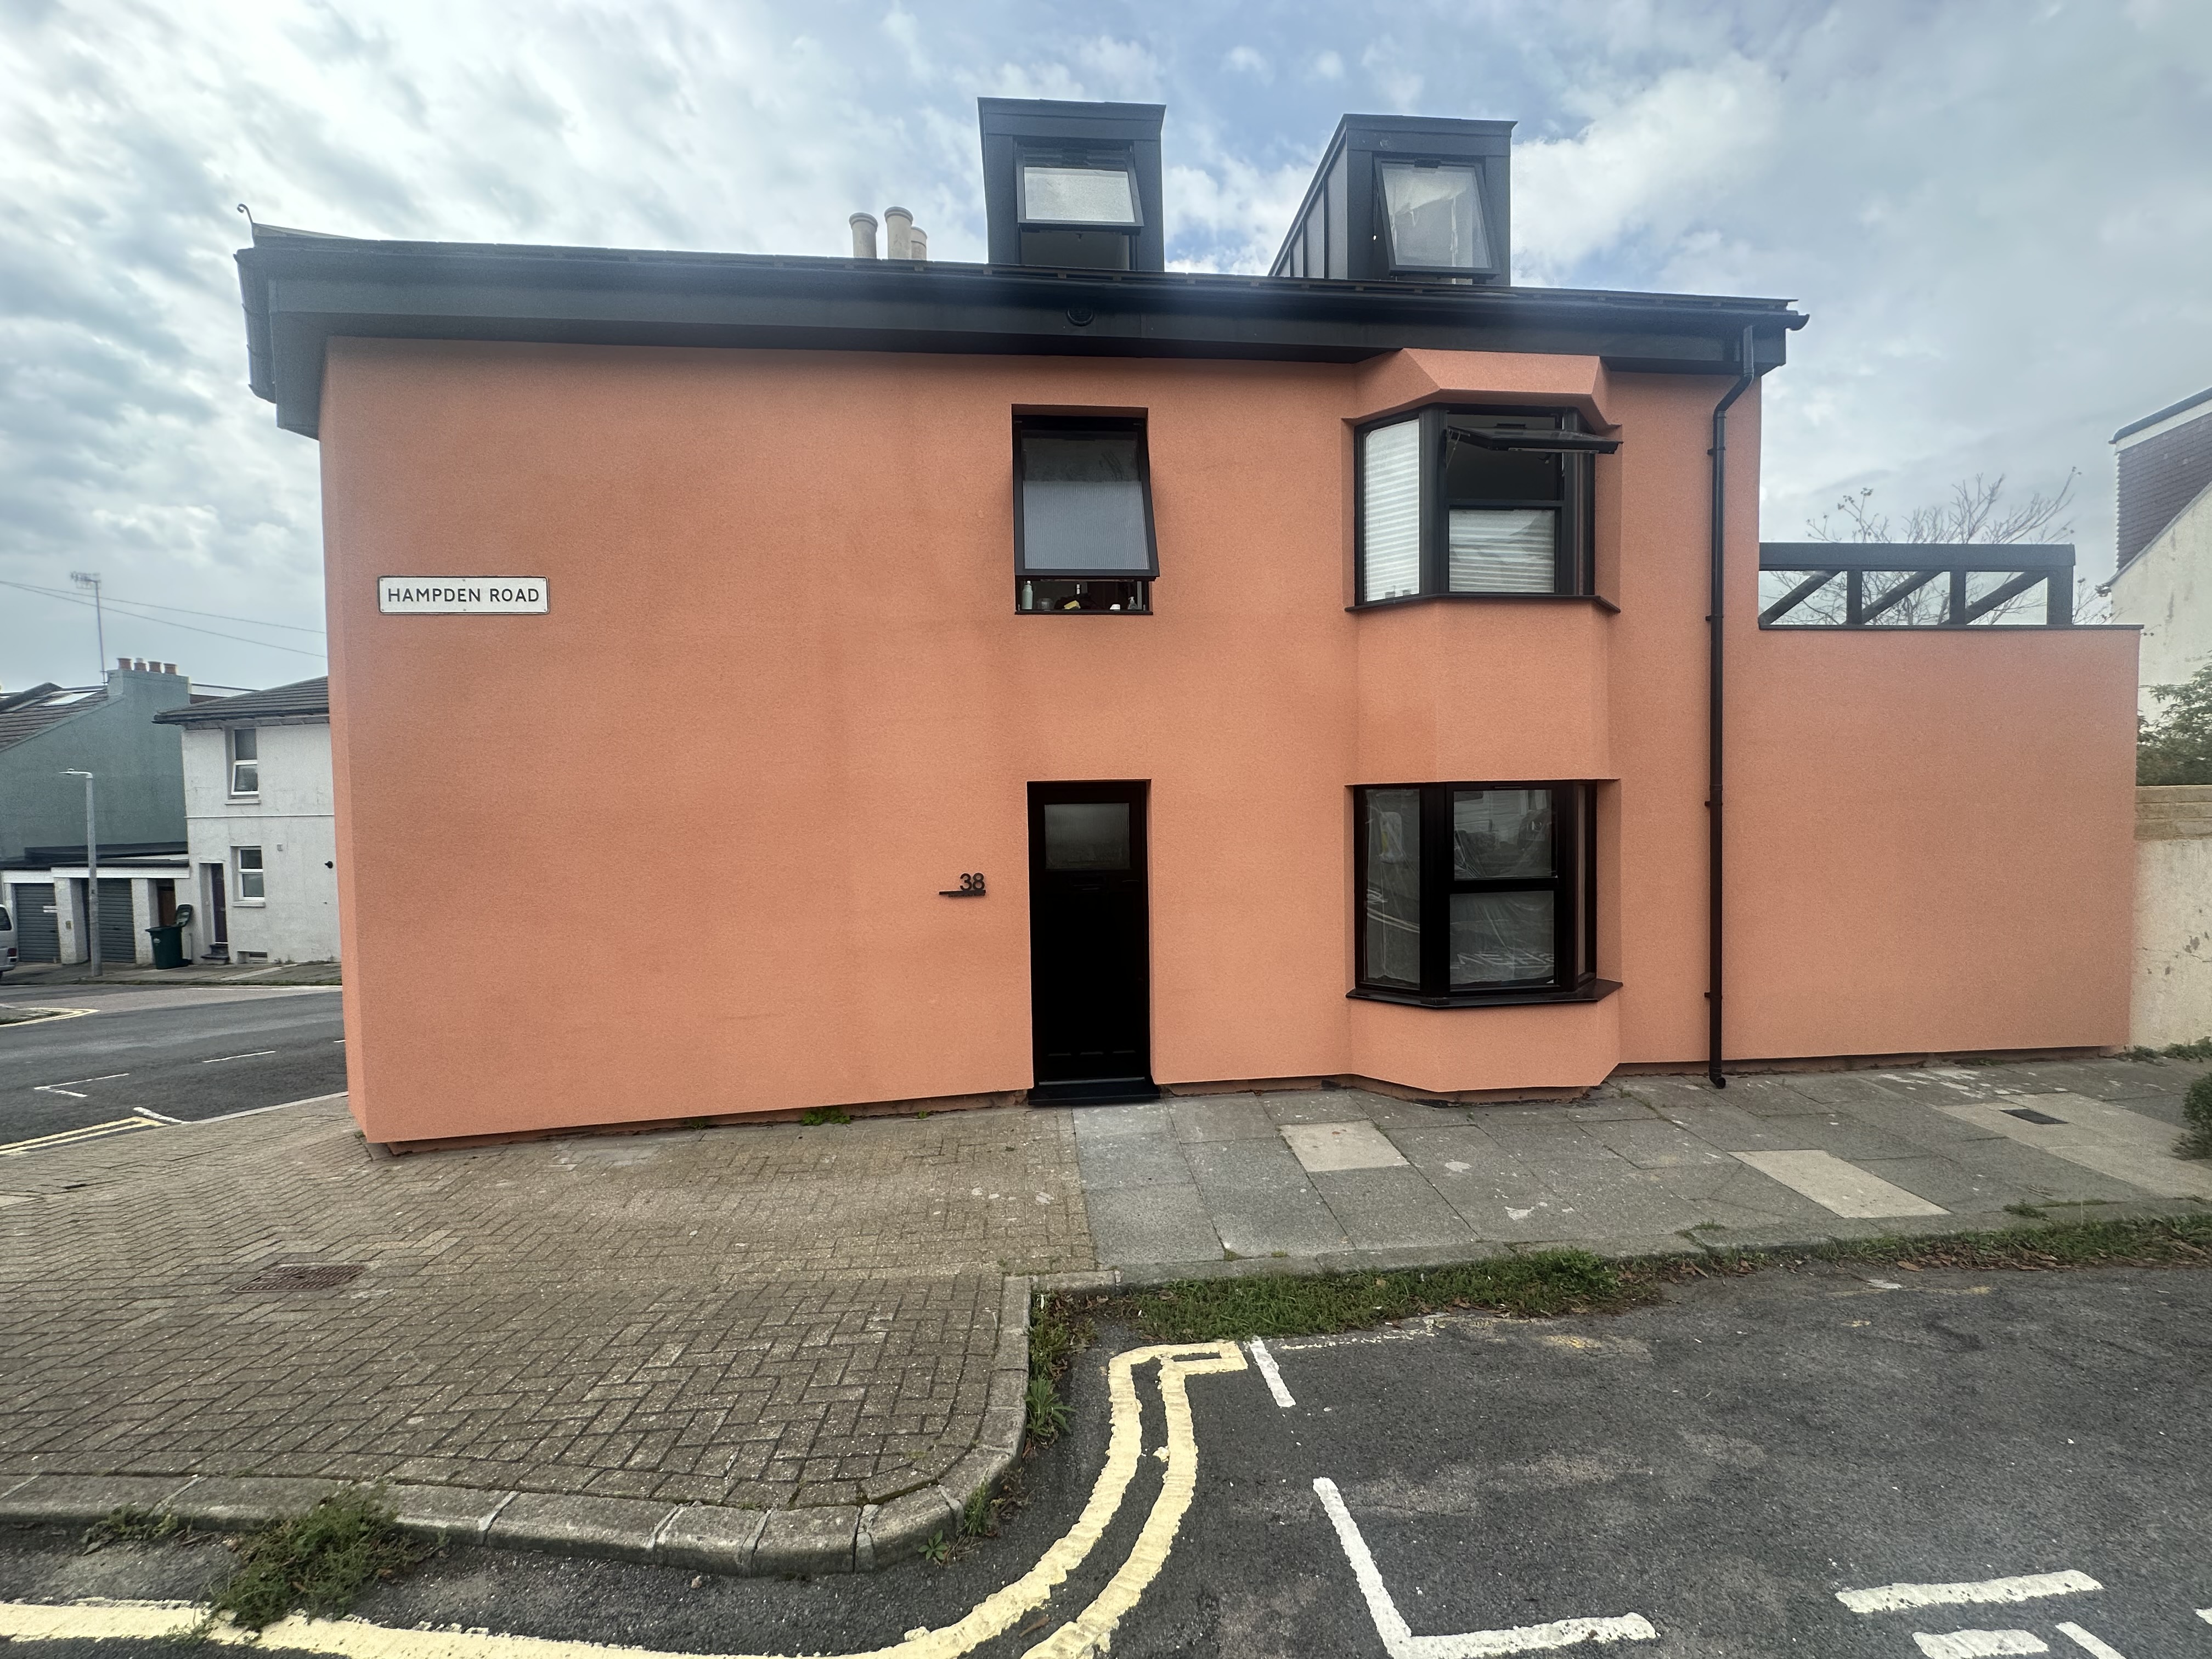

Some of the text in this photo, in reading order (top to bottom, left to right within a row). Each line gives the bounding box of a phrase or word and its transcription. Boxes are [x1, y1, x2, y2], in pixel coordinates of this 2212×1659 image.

[388, 588, 539, 602] HAMPDEN ROAD
[960, 872, 985, 891] 38
